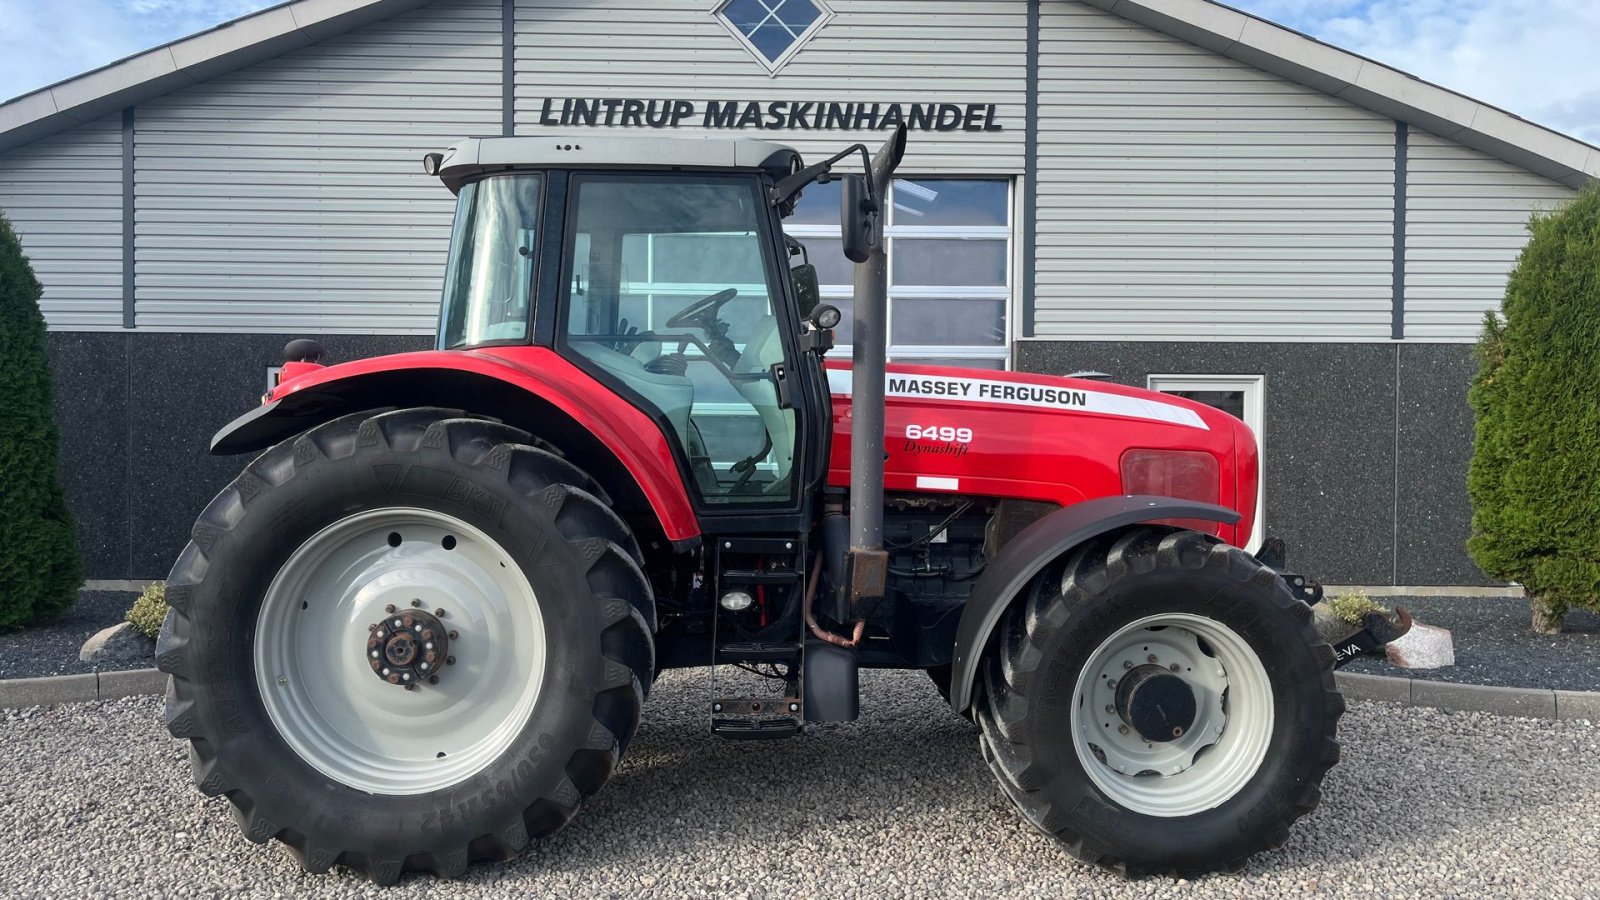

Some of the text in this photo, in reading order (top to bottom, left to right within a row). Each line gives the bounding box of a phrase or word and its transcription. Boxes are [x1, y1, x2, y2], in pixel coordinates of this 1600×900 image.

[539, 97, 1003, 131] LINTRUP MASKINHANDEL
[889, 378, 1087, 406] MASSEY FERGUSON
[905, 424, 973, 443] 6499
[903, 440, 969, 458] Dynashift
[450, 474, 508, 528] BKT
